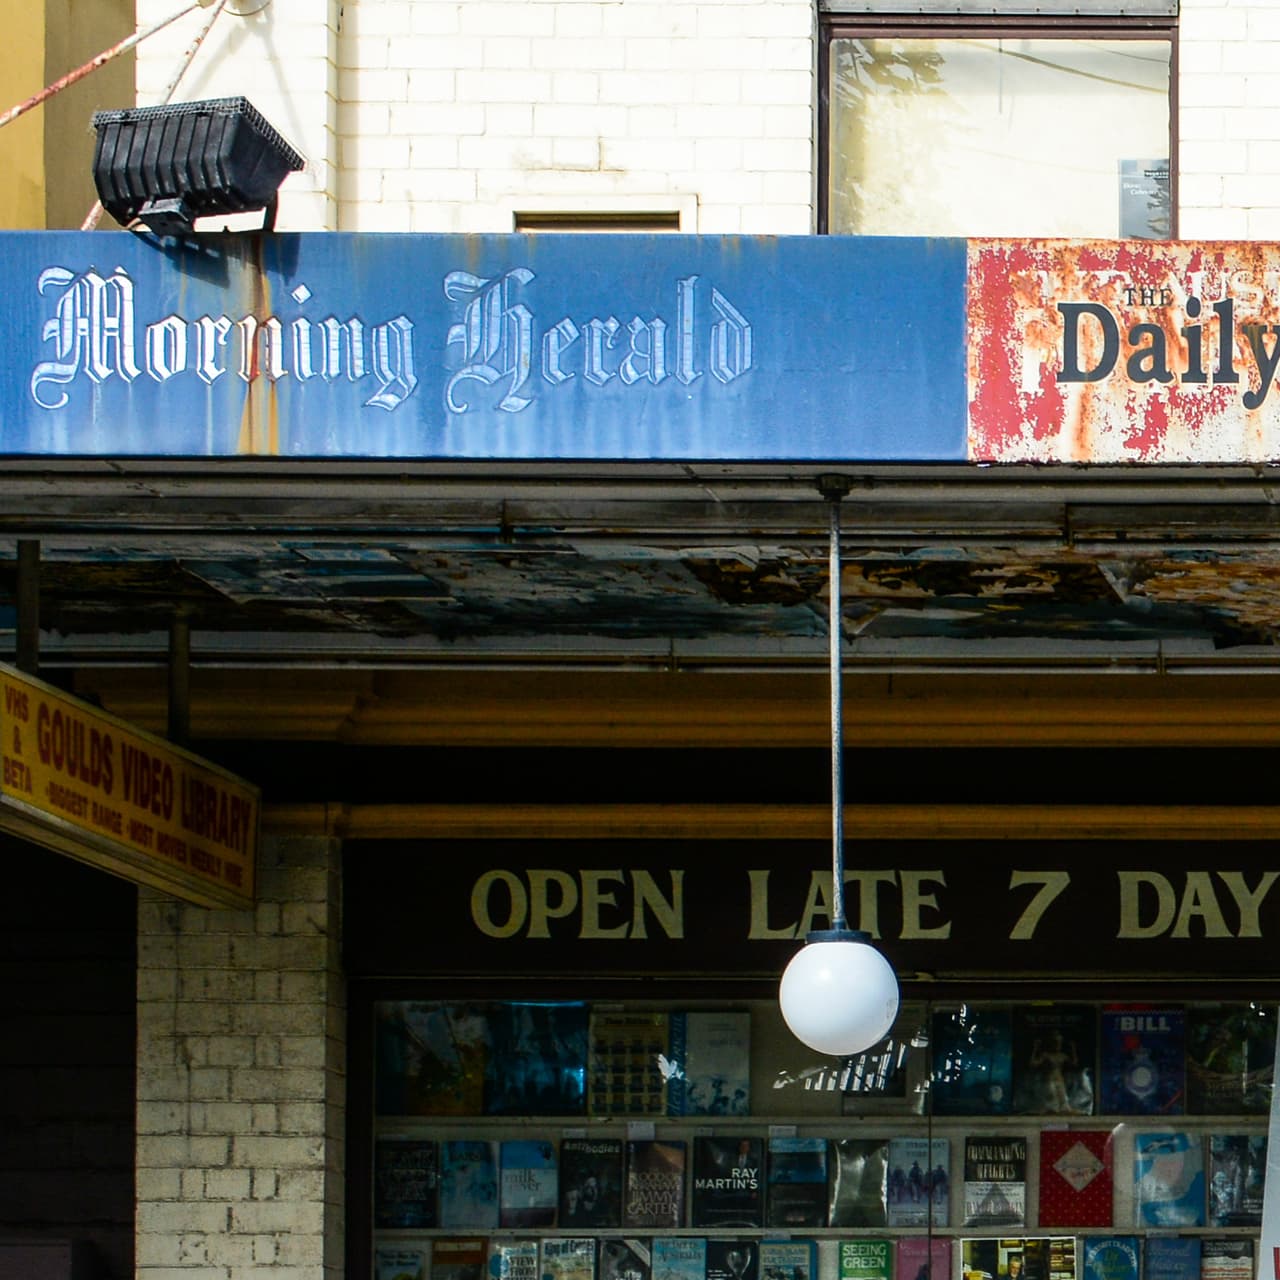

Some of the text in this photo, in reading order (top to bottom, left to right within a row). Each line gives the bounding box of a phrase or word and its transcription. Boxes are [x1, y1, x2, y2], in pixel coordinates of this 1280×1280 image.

[32, 264, 754, 413] Morning Herald
[5, 684, 29, 723] VHS
[4, 757, 32, 795] BETA
[38, 702, 113, 795] GOULDS
[122, 741, 174, 821] VIDEO
[181, 772, 251, 856] LIBRARY
[470, 869, 686, 941] OPEN
[747, 870, 952, 940] LATE
[1008, 871, 1071, 940] 7
[1119, 1015, 1171, 1032] BILL
[695, 1178, 759, 1190] MARTIN'S
[731, 1167, 759, 1178] RAY
[843, 1244, 887, 1256] SEEING
[843, 1256, 886, 1268] GREEN
